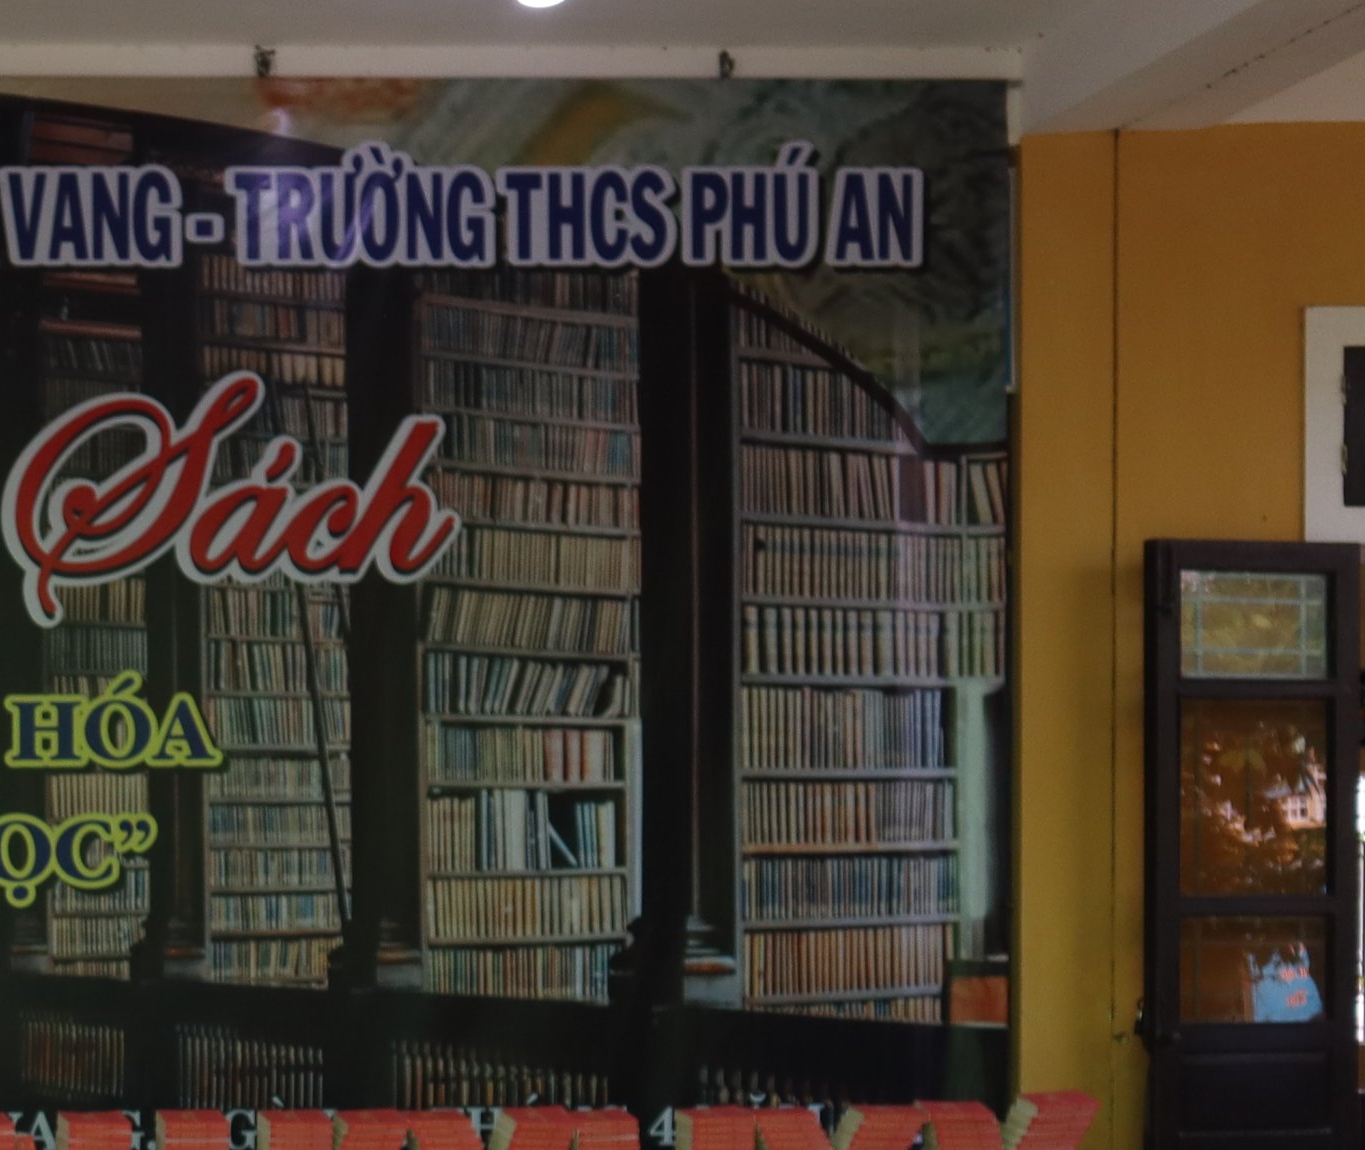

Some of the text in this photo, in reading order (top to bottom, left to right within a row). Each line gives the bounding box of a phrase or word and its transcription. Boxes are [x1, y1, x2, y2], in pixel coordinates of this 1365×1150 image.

[225, 141, 495, 268] TRƯỜNG
[497, 165, 675, 268] THCS
[681, 141, 817, 268] PHÚ
[825, 166, 922, 268] AN
[1, 370, 462, 629] Sách
[5, 671, 223, 768] HÓA
